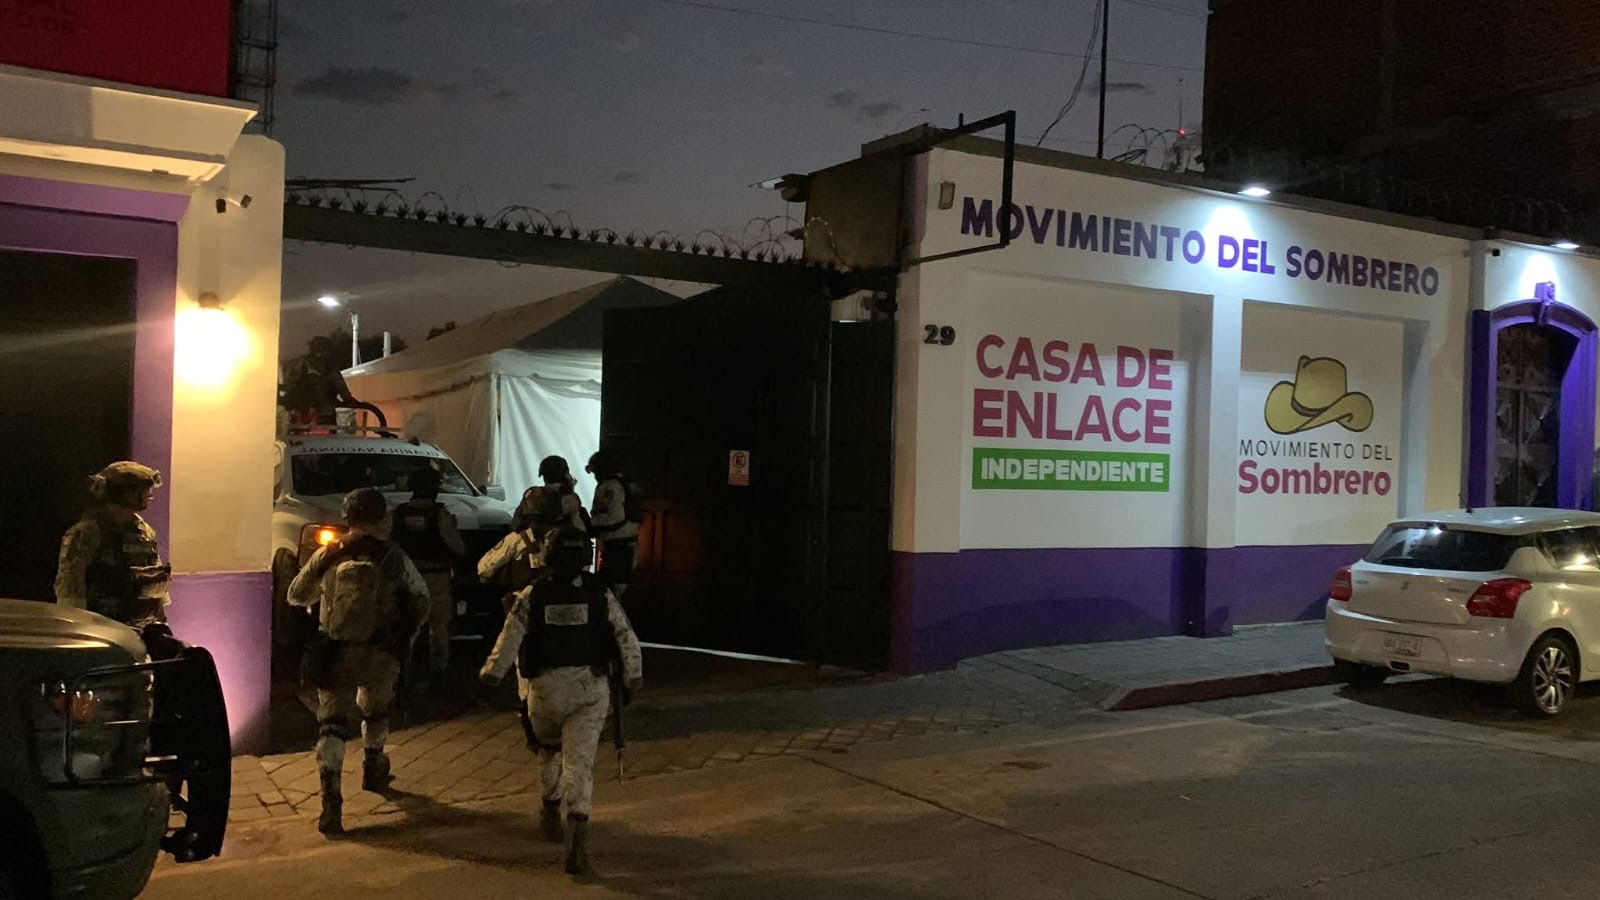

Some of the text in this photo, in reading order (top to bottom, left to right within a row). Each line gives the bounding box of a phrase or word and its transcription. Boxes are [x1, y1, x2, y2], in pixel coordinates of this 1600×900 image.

[961, 197, 1440, 296] MOVIMIENTO DEL SOMBRERO
[924, 325, 956, 346] 29
[976, 334, 1174, 391] CASA DE
[972, 388, 1171, 444] ENLACE
[1240, 439, 1393, 461] MOVIMIENTO DEL
[981, 458, 1164, 483] INDEPENDIENTE
[1238, 460, 1392, 495] Sombrero
